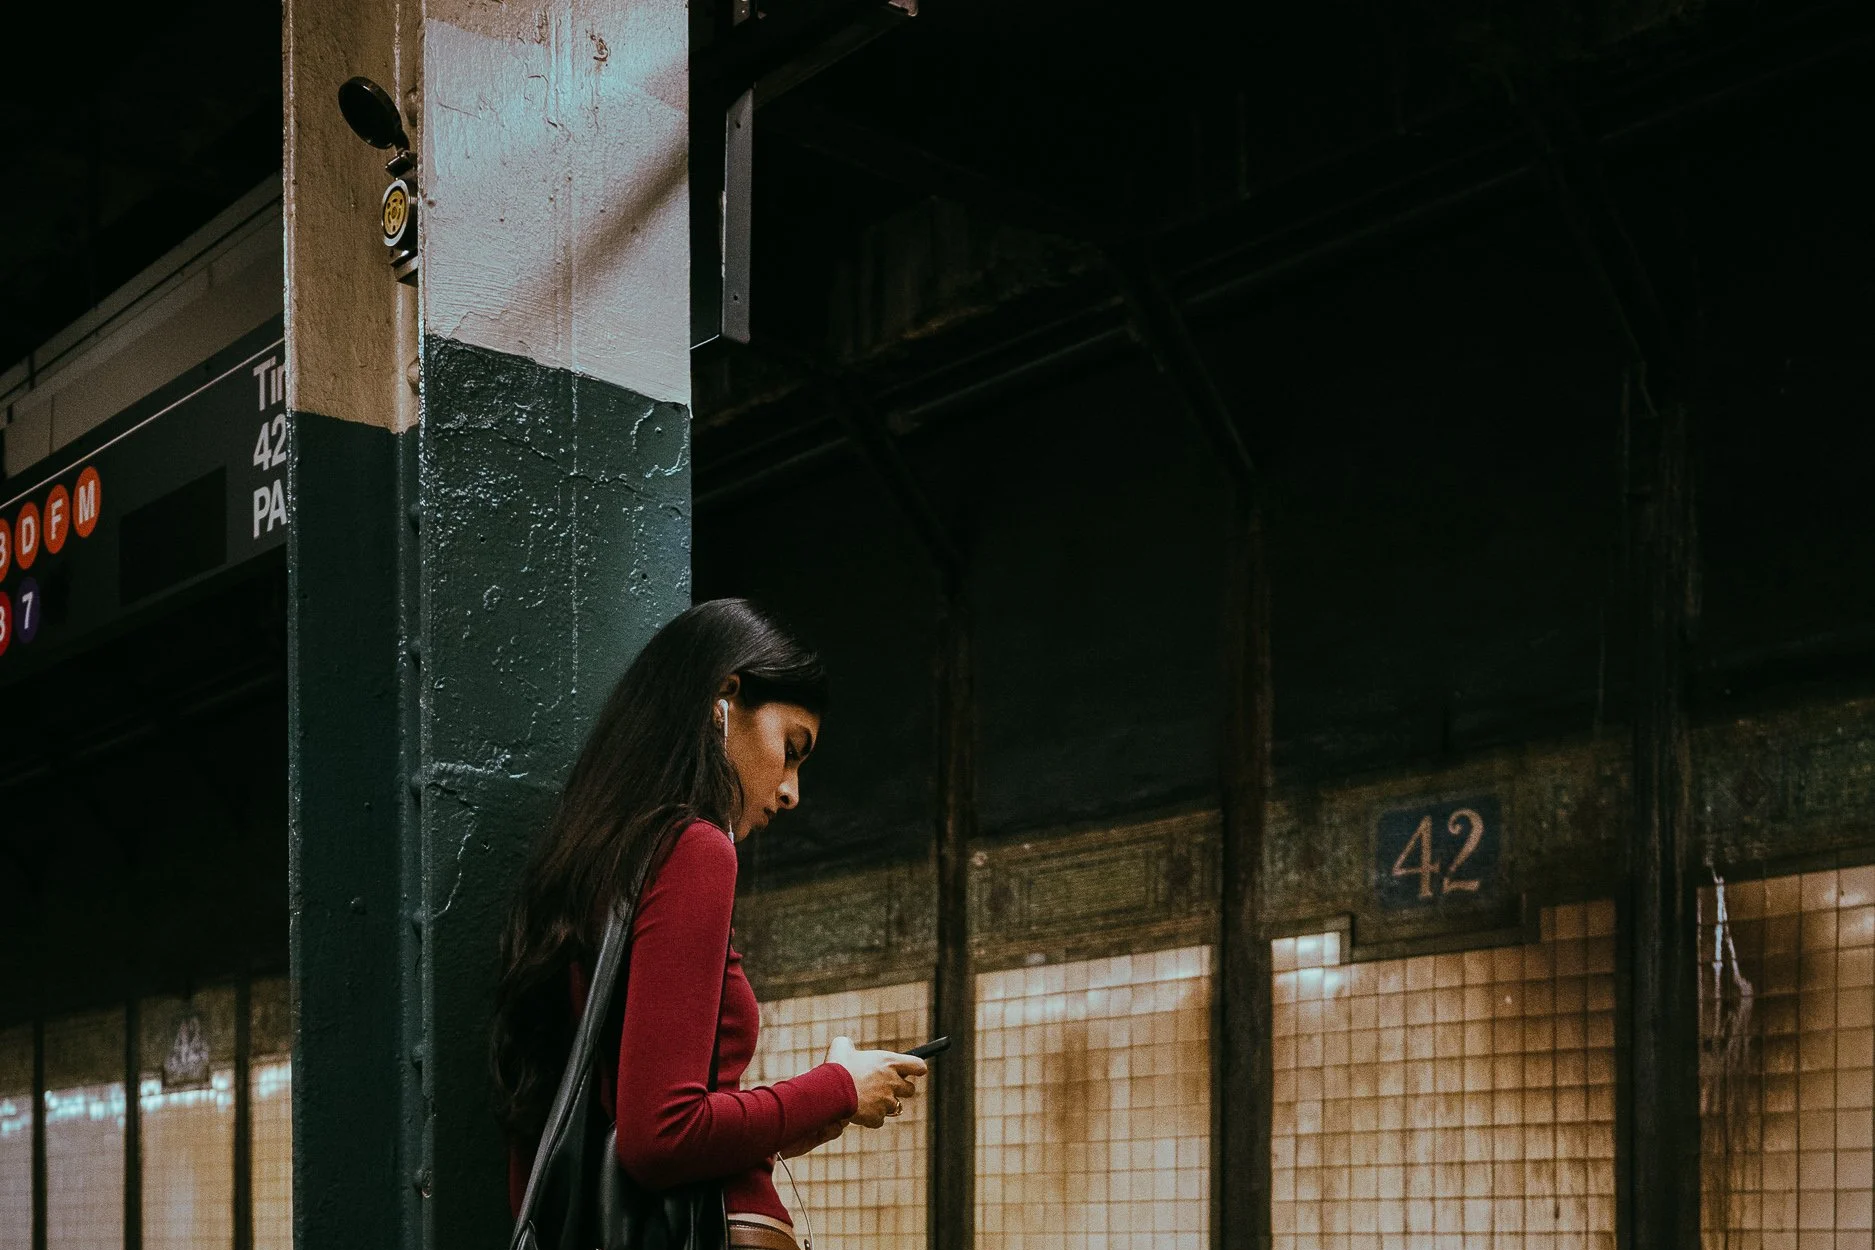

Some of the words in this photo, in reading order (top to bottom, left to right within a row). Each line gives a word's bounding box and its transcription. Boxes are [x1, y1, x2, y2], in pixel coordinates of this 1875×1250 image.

[253, 413, 287, 471] 42
[22, 516, 35, 555] D
[51, 498, 63, 540] F
[78, 480, 96, 524] M
[22, 591, 34, 629] 7
[1392, 808, 1484, 898] 42
